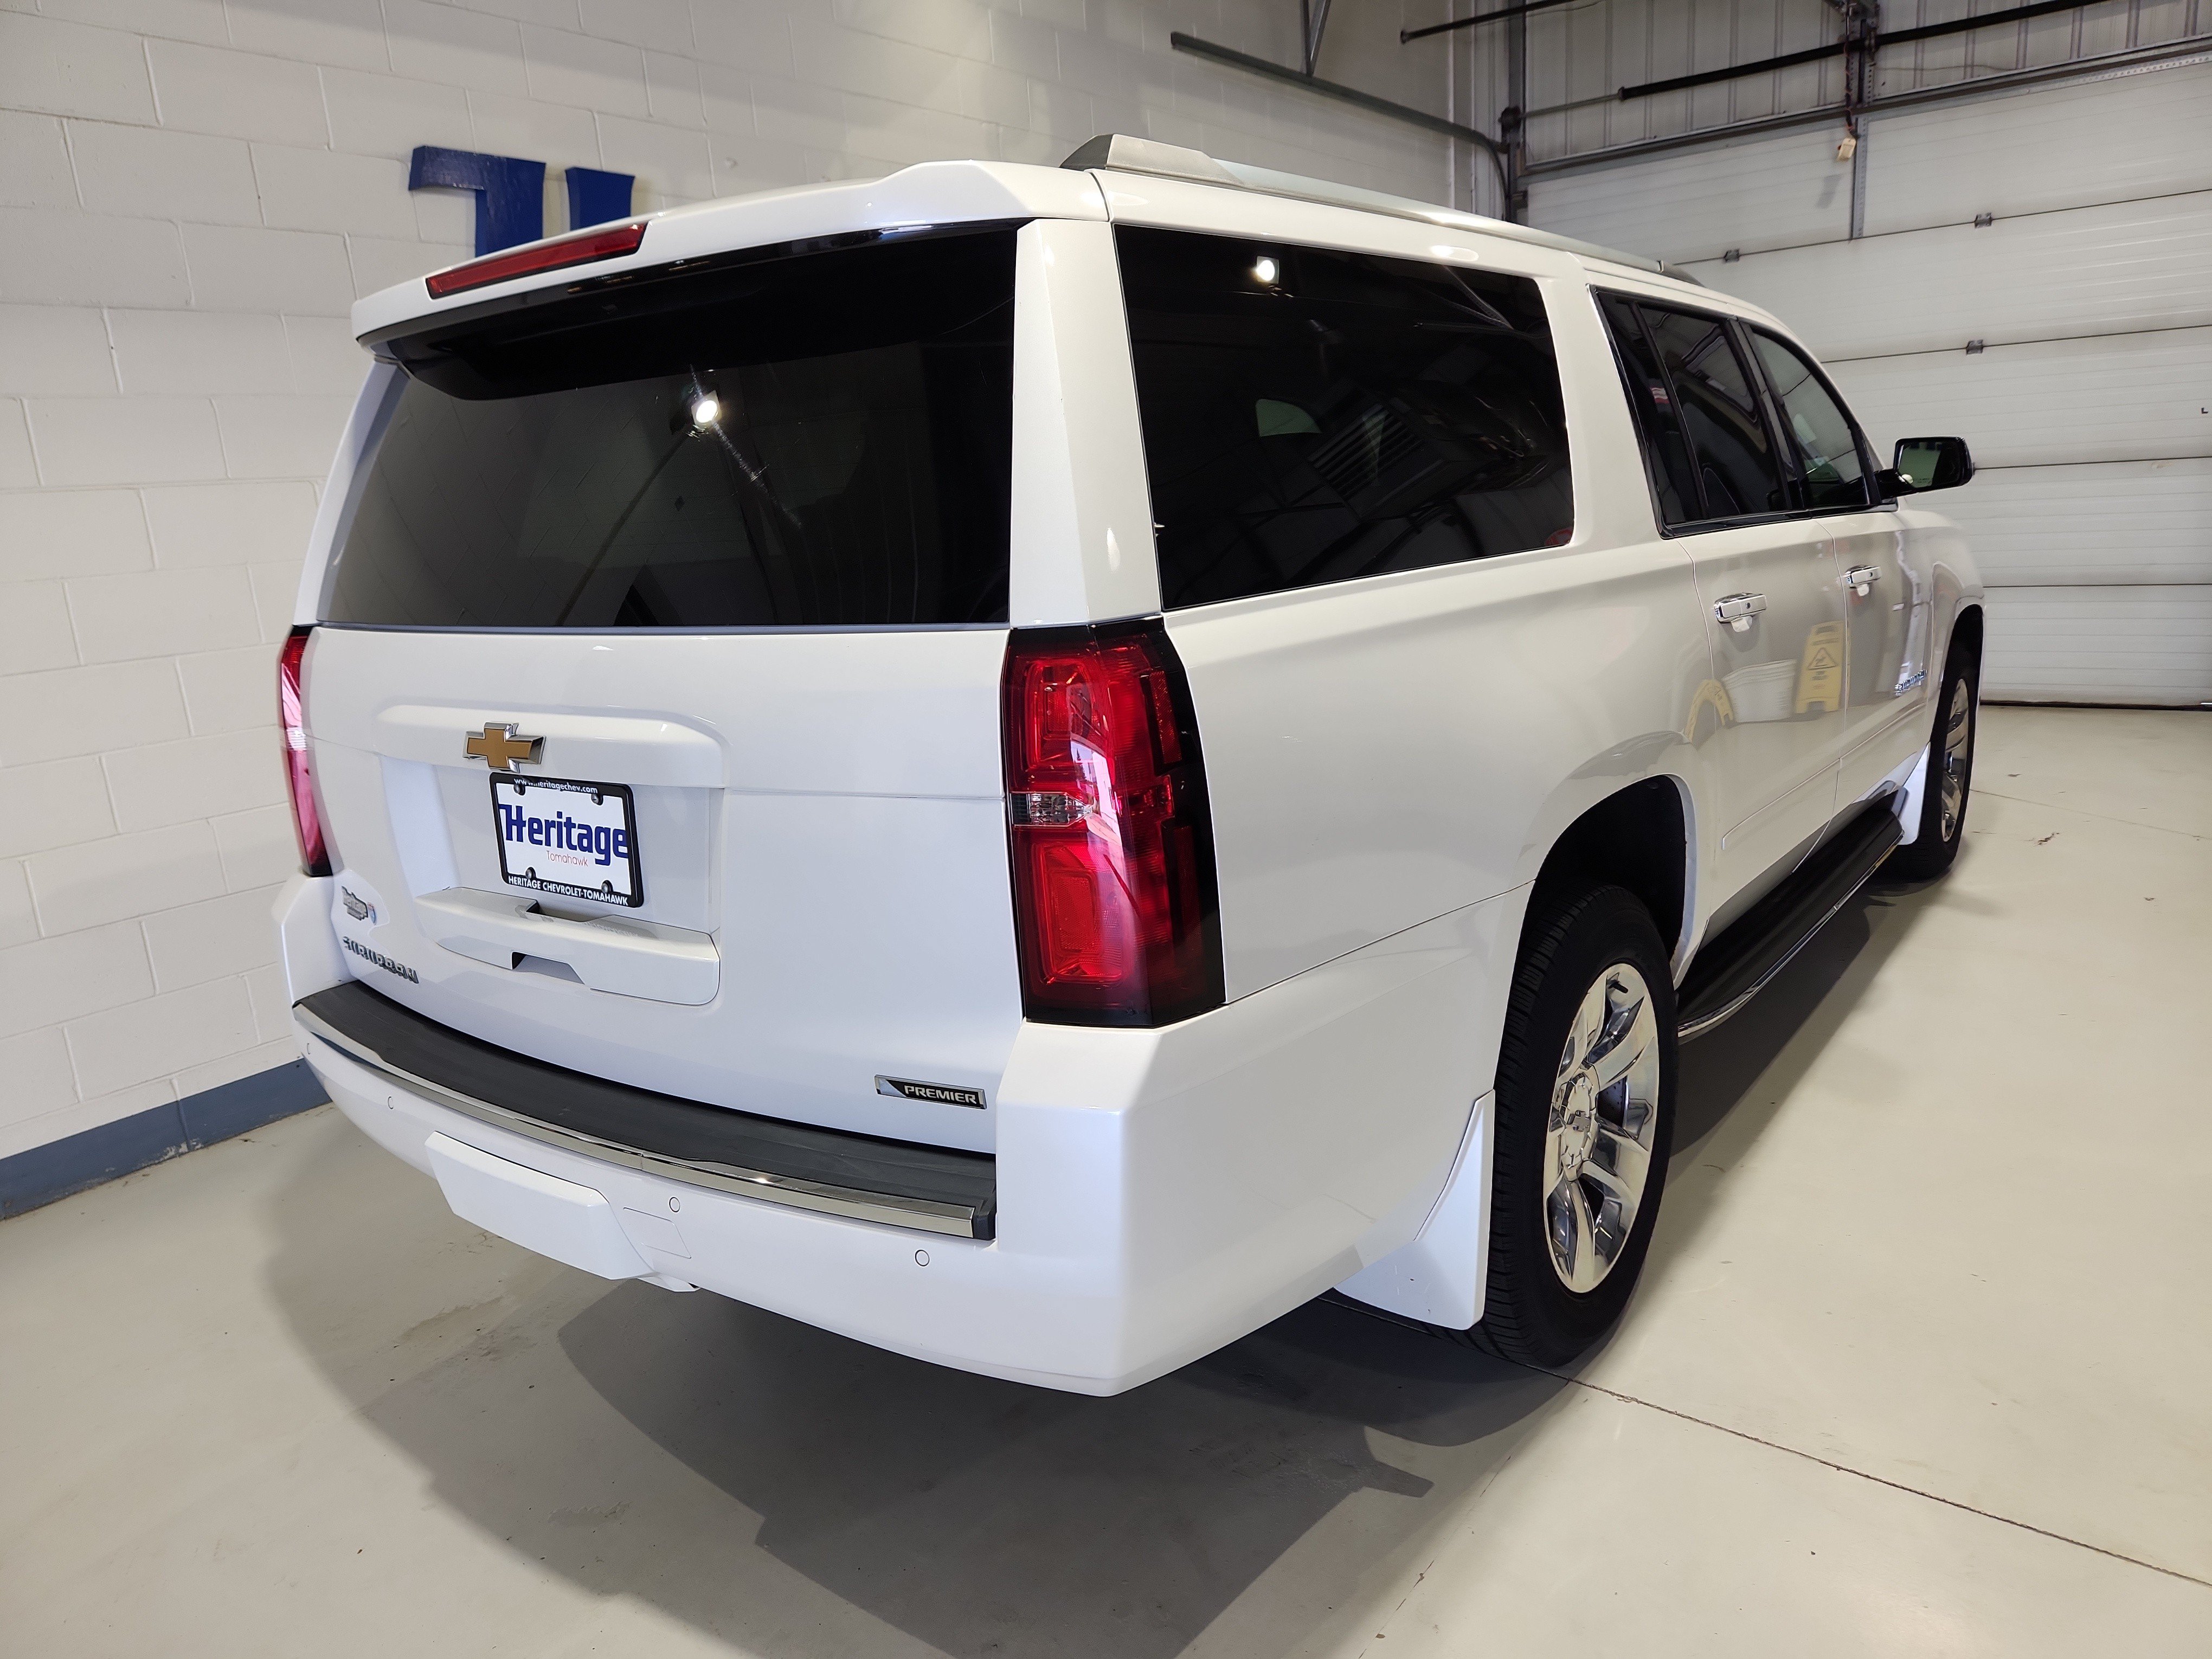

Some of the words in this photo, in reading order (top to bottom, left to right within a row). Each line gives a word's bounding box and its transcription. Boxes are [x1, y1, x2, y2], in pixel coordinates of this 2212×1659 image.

[498, 803, 629, 866] Heritage
[546, 850, 588, 866] Tomahawk
[508, 876, 541, 889] HERITAGE
[904, 1085, 977, 1104] PREMIER
